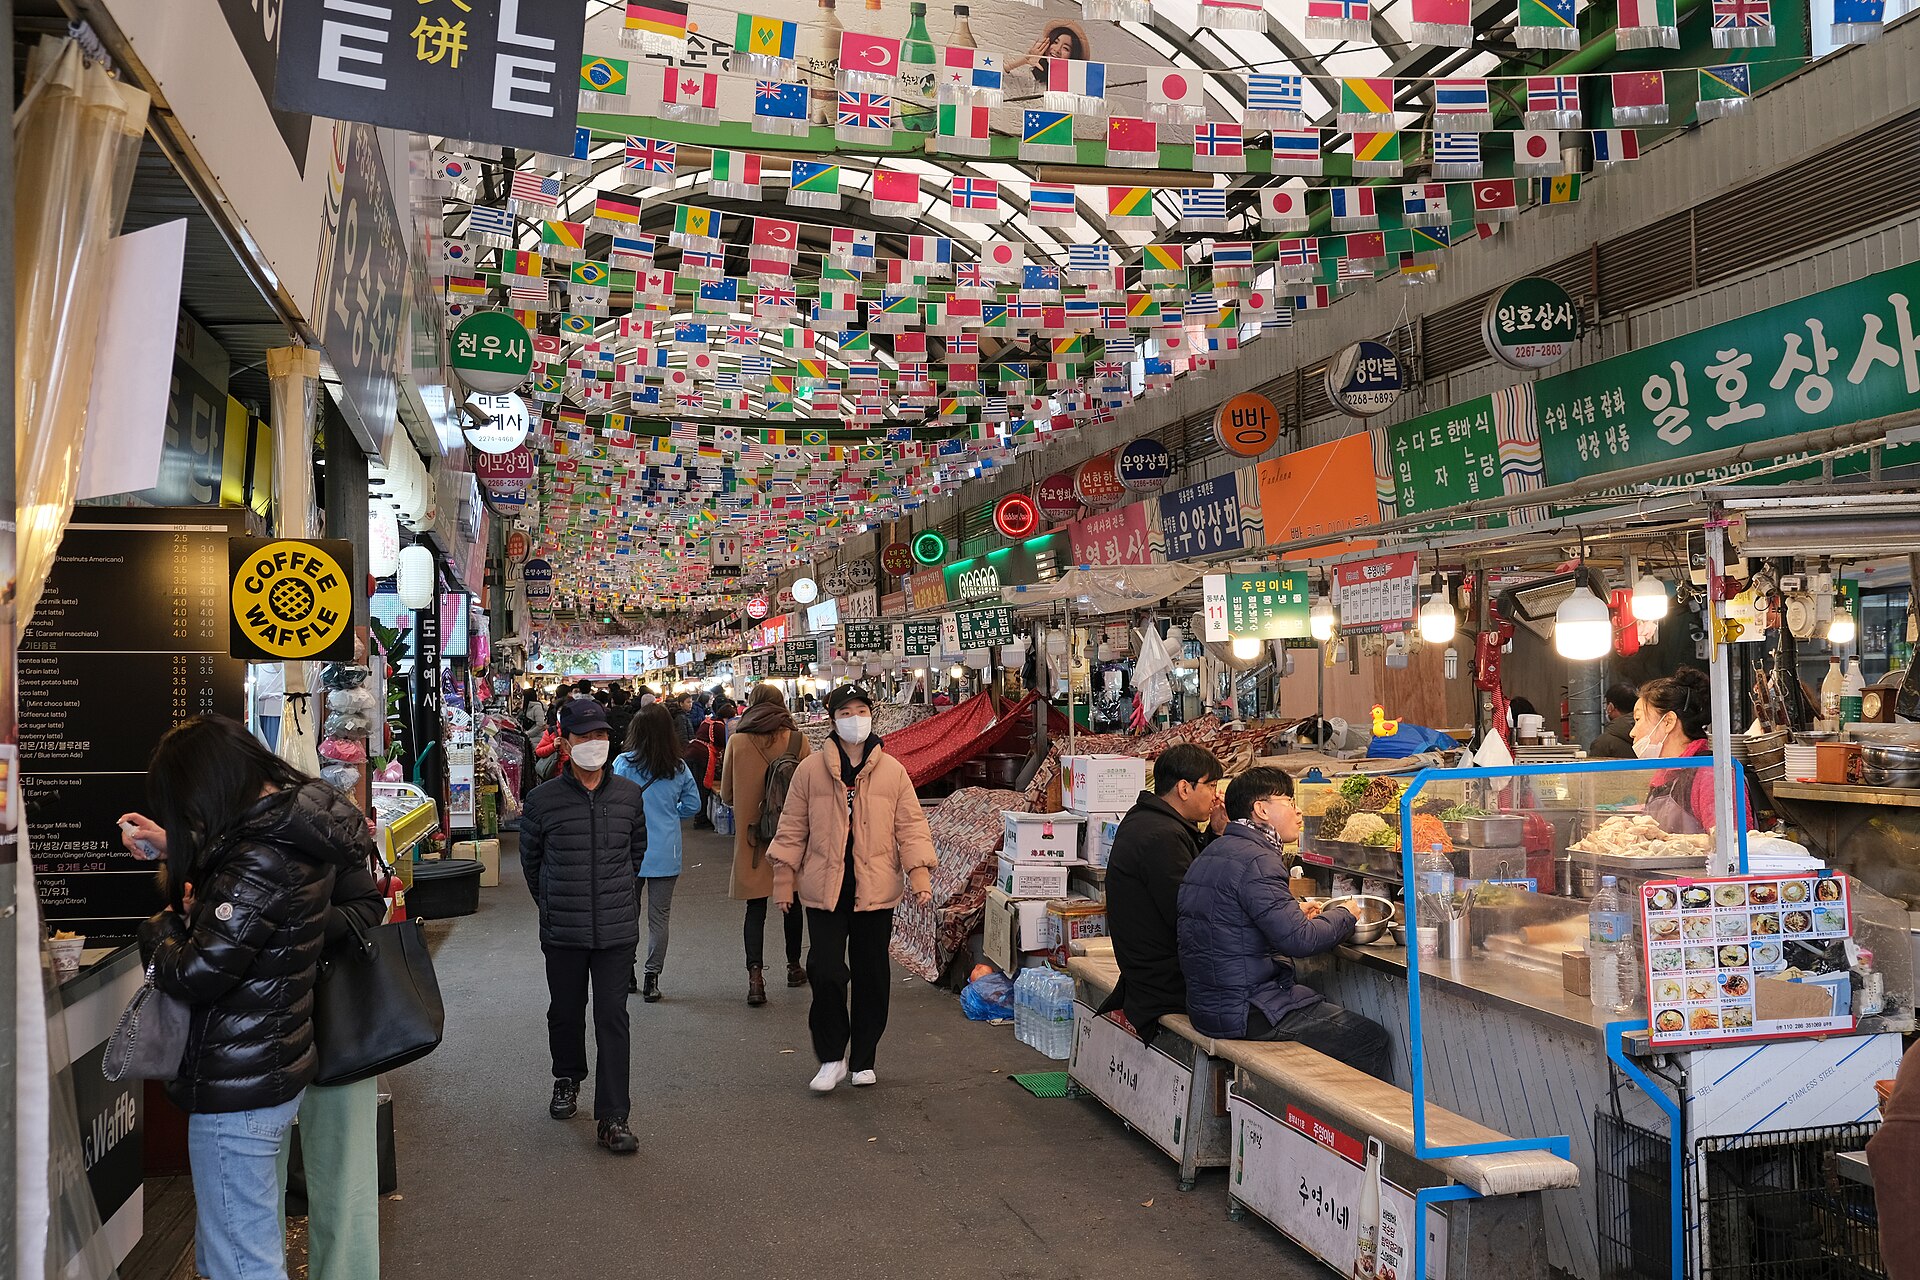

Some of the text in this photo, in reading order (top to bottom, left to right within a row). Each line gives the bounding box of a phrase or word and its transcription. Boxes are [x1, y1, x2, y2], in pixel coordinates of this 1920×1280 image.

[1499, 302, 1573, 333] 일호상사
[457, 332, 526, 363] 천우사
[1515, 344, 1562, 358] 2267-2803
[1642, 293, 1920, 446] 일호상사
[479, 396, 510, 409] 미도
[1347, 392, 1394, 405] 2268-6893
[1544, 407, 1568, 434] 수입
[1572, 397, 1595, 426] 식품
[1230, 405, 1272, 442] 빵
[1576, 424, 1630, 462] 냉장 냉동
[479, 452, 530, 474] 이모상회
[1122, 453, 1169, 471] 우양상회
[1082, 471, 1119, 488] 선한한
[1179, 495, 1240, 553] 우양상회
[55, 555, 88, 564] (Hazelnuts
[89, 555, 124, 564] Americano)
[245, 551, 338, 594] COFFEE
[1241, 579, 1293, 593] 주영이네
[1209, 606, 1222, 618] 11
[245, 603, 339, 647] WAFFLE
[946, 625, 955, 633] 12
[1213, 621, 1221, 630] 호
[36, 630, 64, 638] (Caramel
[786, 641, 814, 650] 강원도
[172, 656, 186, 664] 3.5
[199, 656, 213, 664] 3.5
[172, 667, 186, 675] 3.5
[199, 667, 213, 675] 3.5
[172, 677, 186, 686] 3.5
[172, 688, 186, 696] 4.0
[199, 688, 213, 696] 4.0
[172, 699, 186, 707] 3.5
[199, 699, 213, 707] 3.5
[172, 709, 186, 717] 4.0
[36, 778, 58, 786] (Peach
[30, 841, 109, 850] 자/생강/레몬생강 차
[57, 862, 106, 871] 요거트 스무디
[41, 879, 66, 887] Yogurt)
[1079, 923, 1102, 933] 태양초
[1108, 1055, 1138, 1091] 주영이네
[1787, 1066, 1836, 1105] STAINLESS STEEL
[85, 1090, 136, 1172] & Waffle
[1313, 1122, 1335, 1147] 주영이네
[1298, 1176, 1349, 1231] 주영이네
